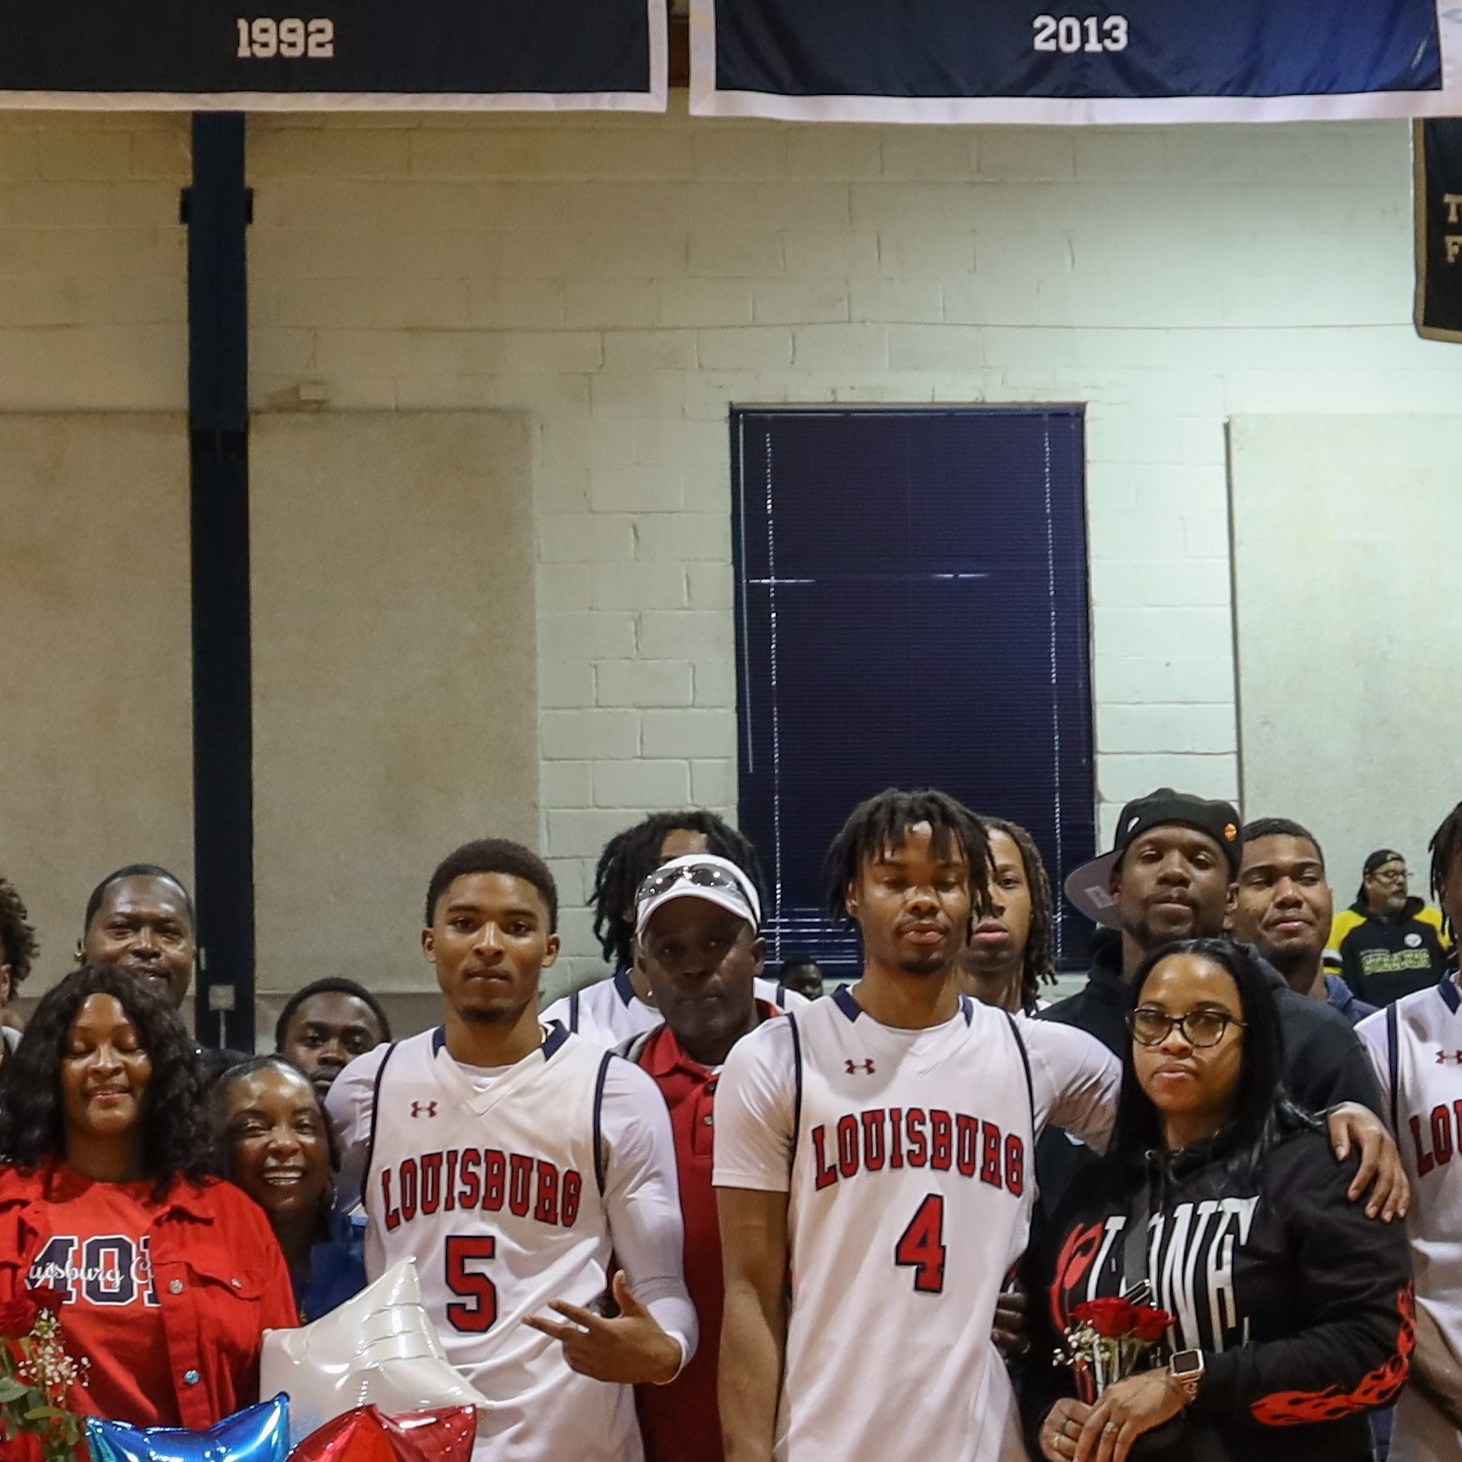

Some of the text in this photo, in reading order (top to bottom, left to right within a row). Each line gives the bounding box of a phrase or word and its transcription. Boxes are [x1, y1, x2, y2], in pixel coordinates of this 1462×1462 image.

[237, 18, 334, 57] 1992
[1033, 15, 1128, 53] 2013
[382, 1148, 583, 1230] LOUISBURG
[812, 1108, 1025, 1198] LOUISBURG
[445, 1236, 497, 1332] 5
[896, 1194, 946, 1292] 4
